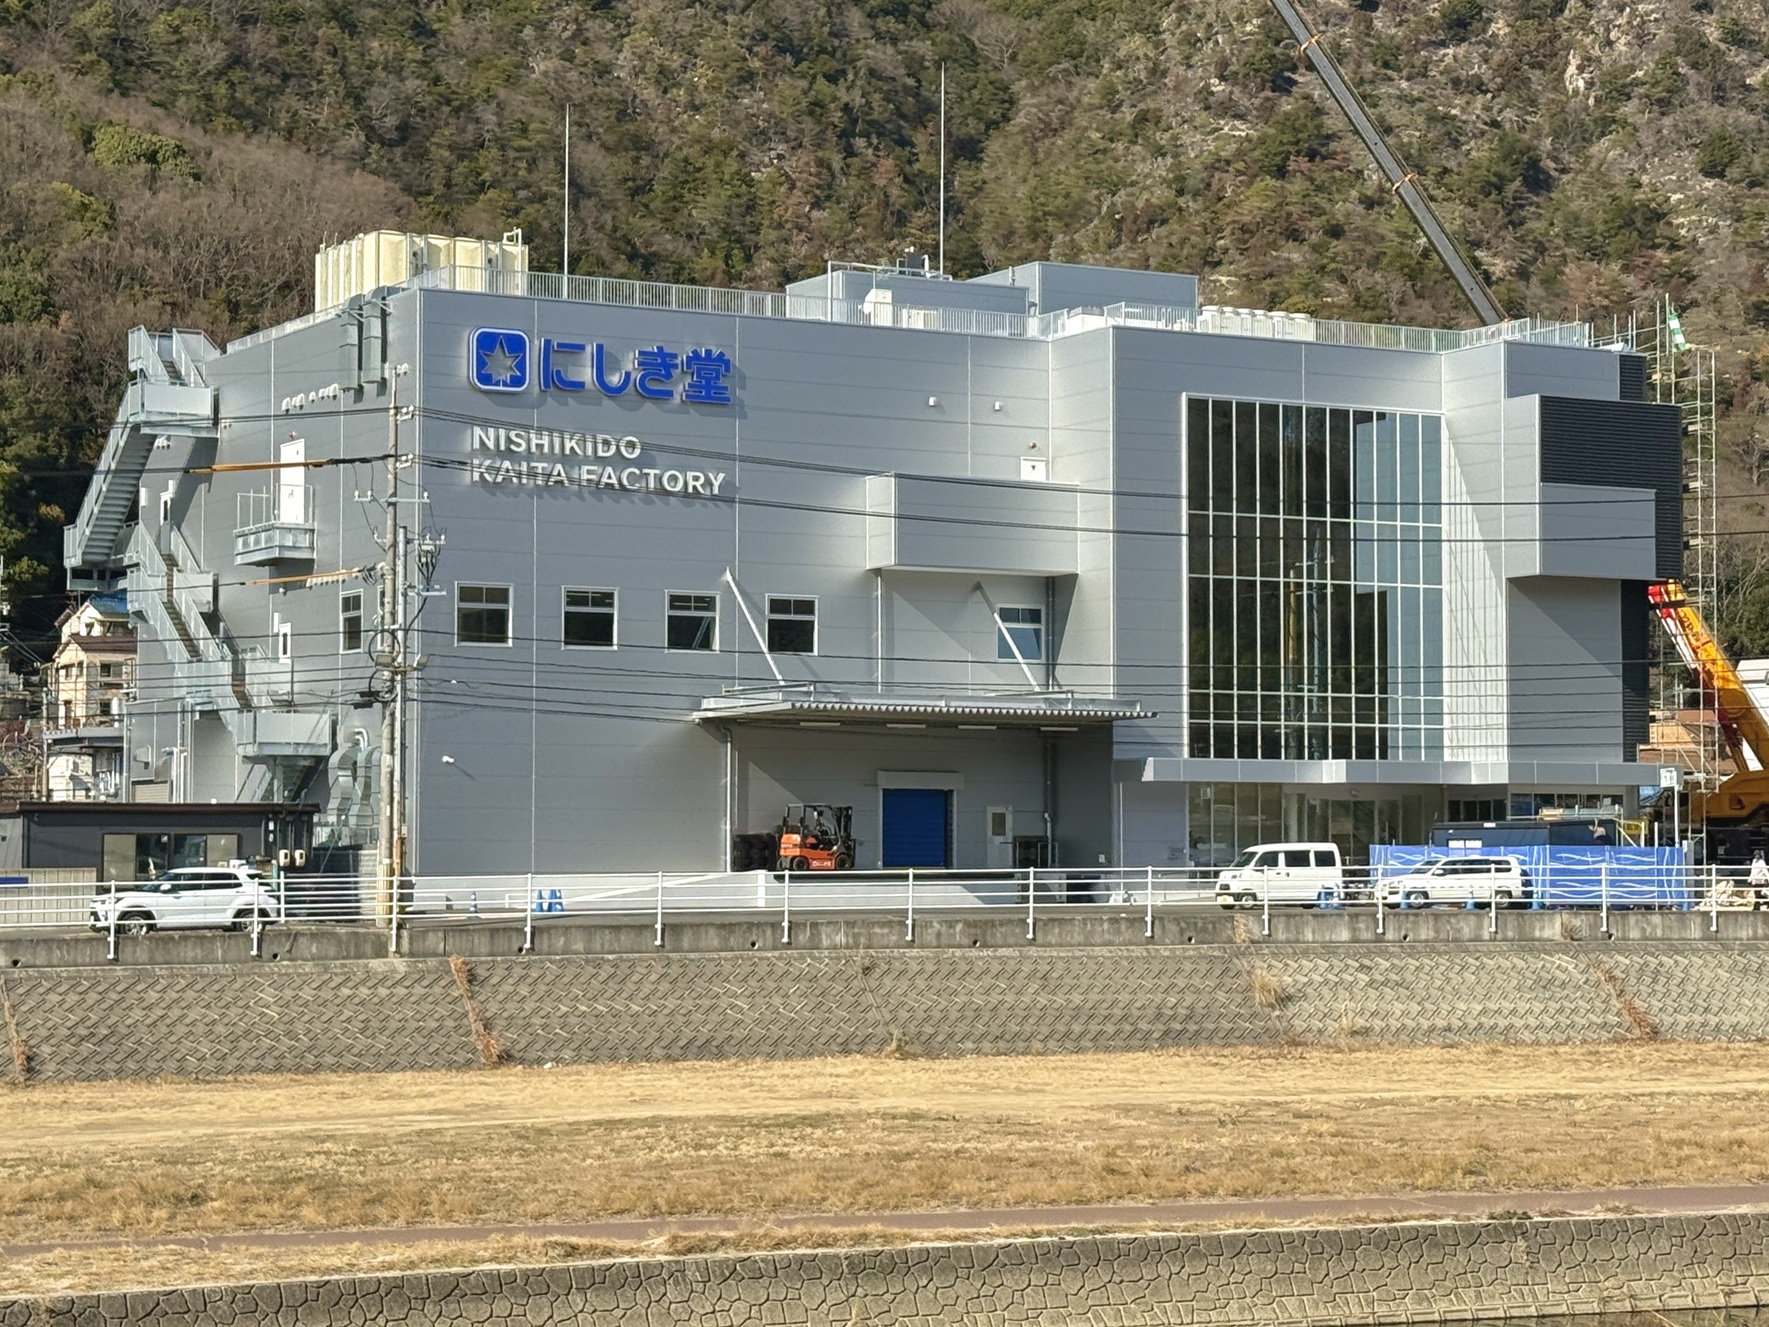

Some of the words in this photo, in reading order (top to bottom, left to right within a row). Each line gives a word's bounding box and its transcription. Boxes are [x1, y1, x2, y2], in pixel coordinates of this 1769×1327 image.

[540, 338, 732, 404] にしき堂
[471, 425, 642, 460] NISHIKIDO
[471, 458, 570, 487] KAITA
[579, 464, 727, 496] FACTORY
